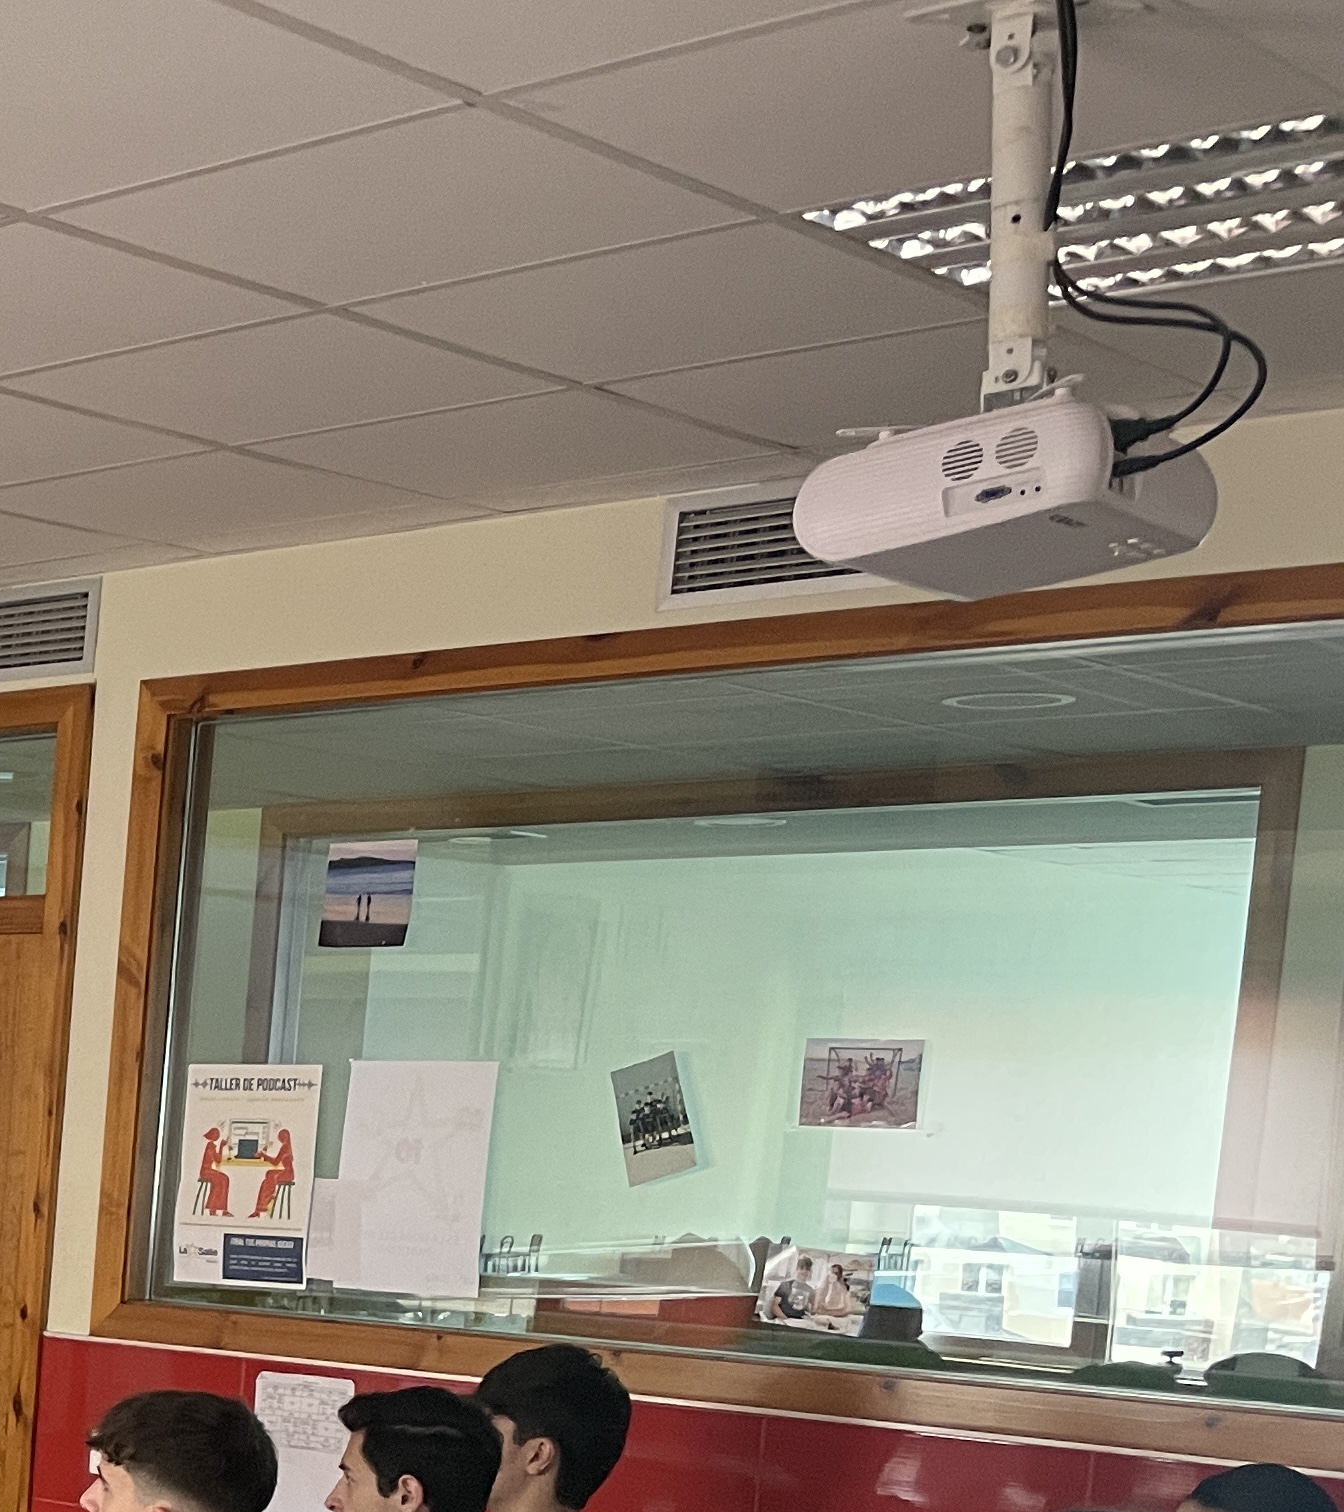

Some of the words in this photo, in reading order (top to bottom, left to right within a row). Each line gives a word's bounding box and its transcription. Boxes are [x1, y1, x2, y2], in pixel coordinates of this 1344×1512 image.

[209, 1077, 241, 1091] TALLER
[243, 1077, 255, 1091] DE
[256, 1077, 298, 1092] PODCAST
